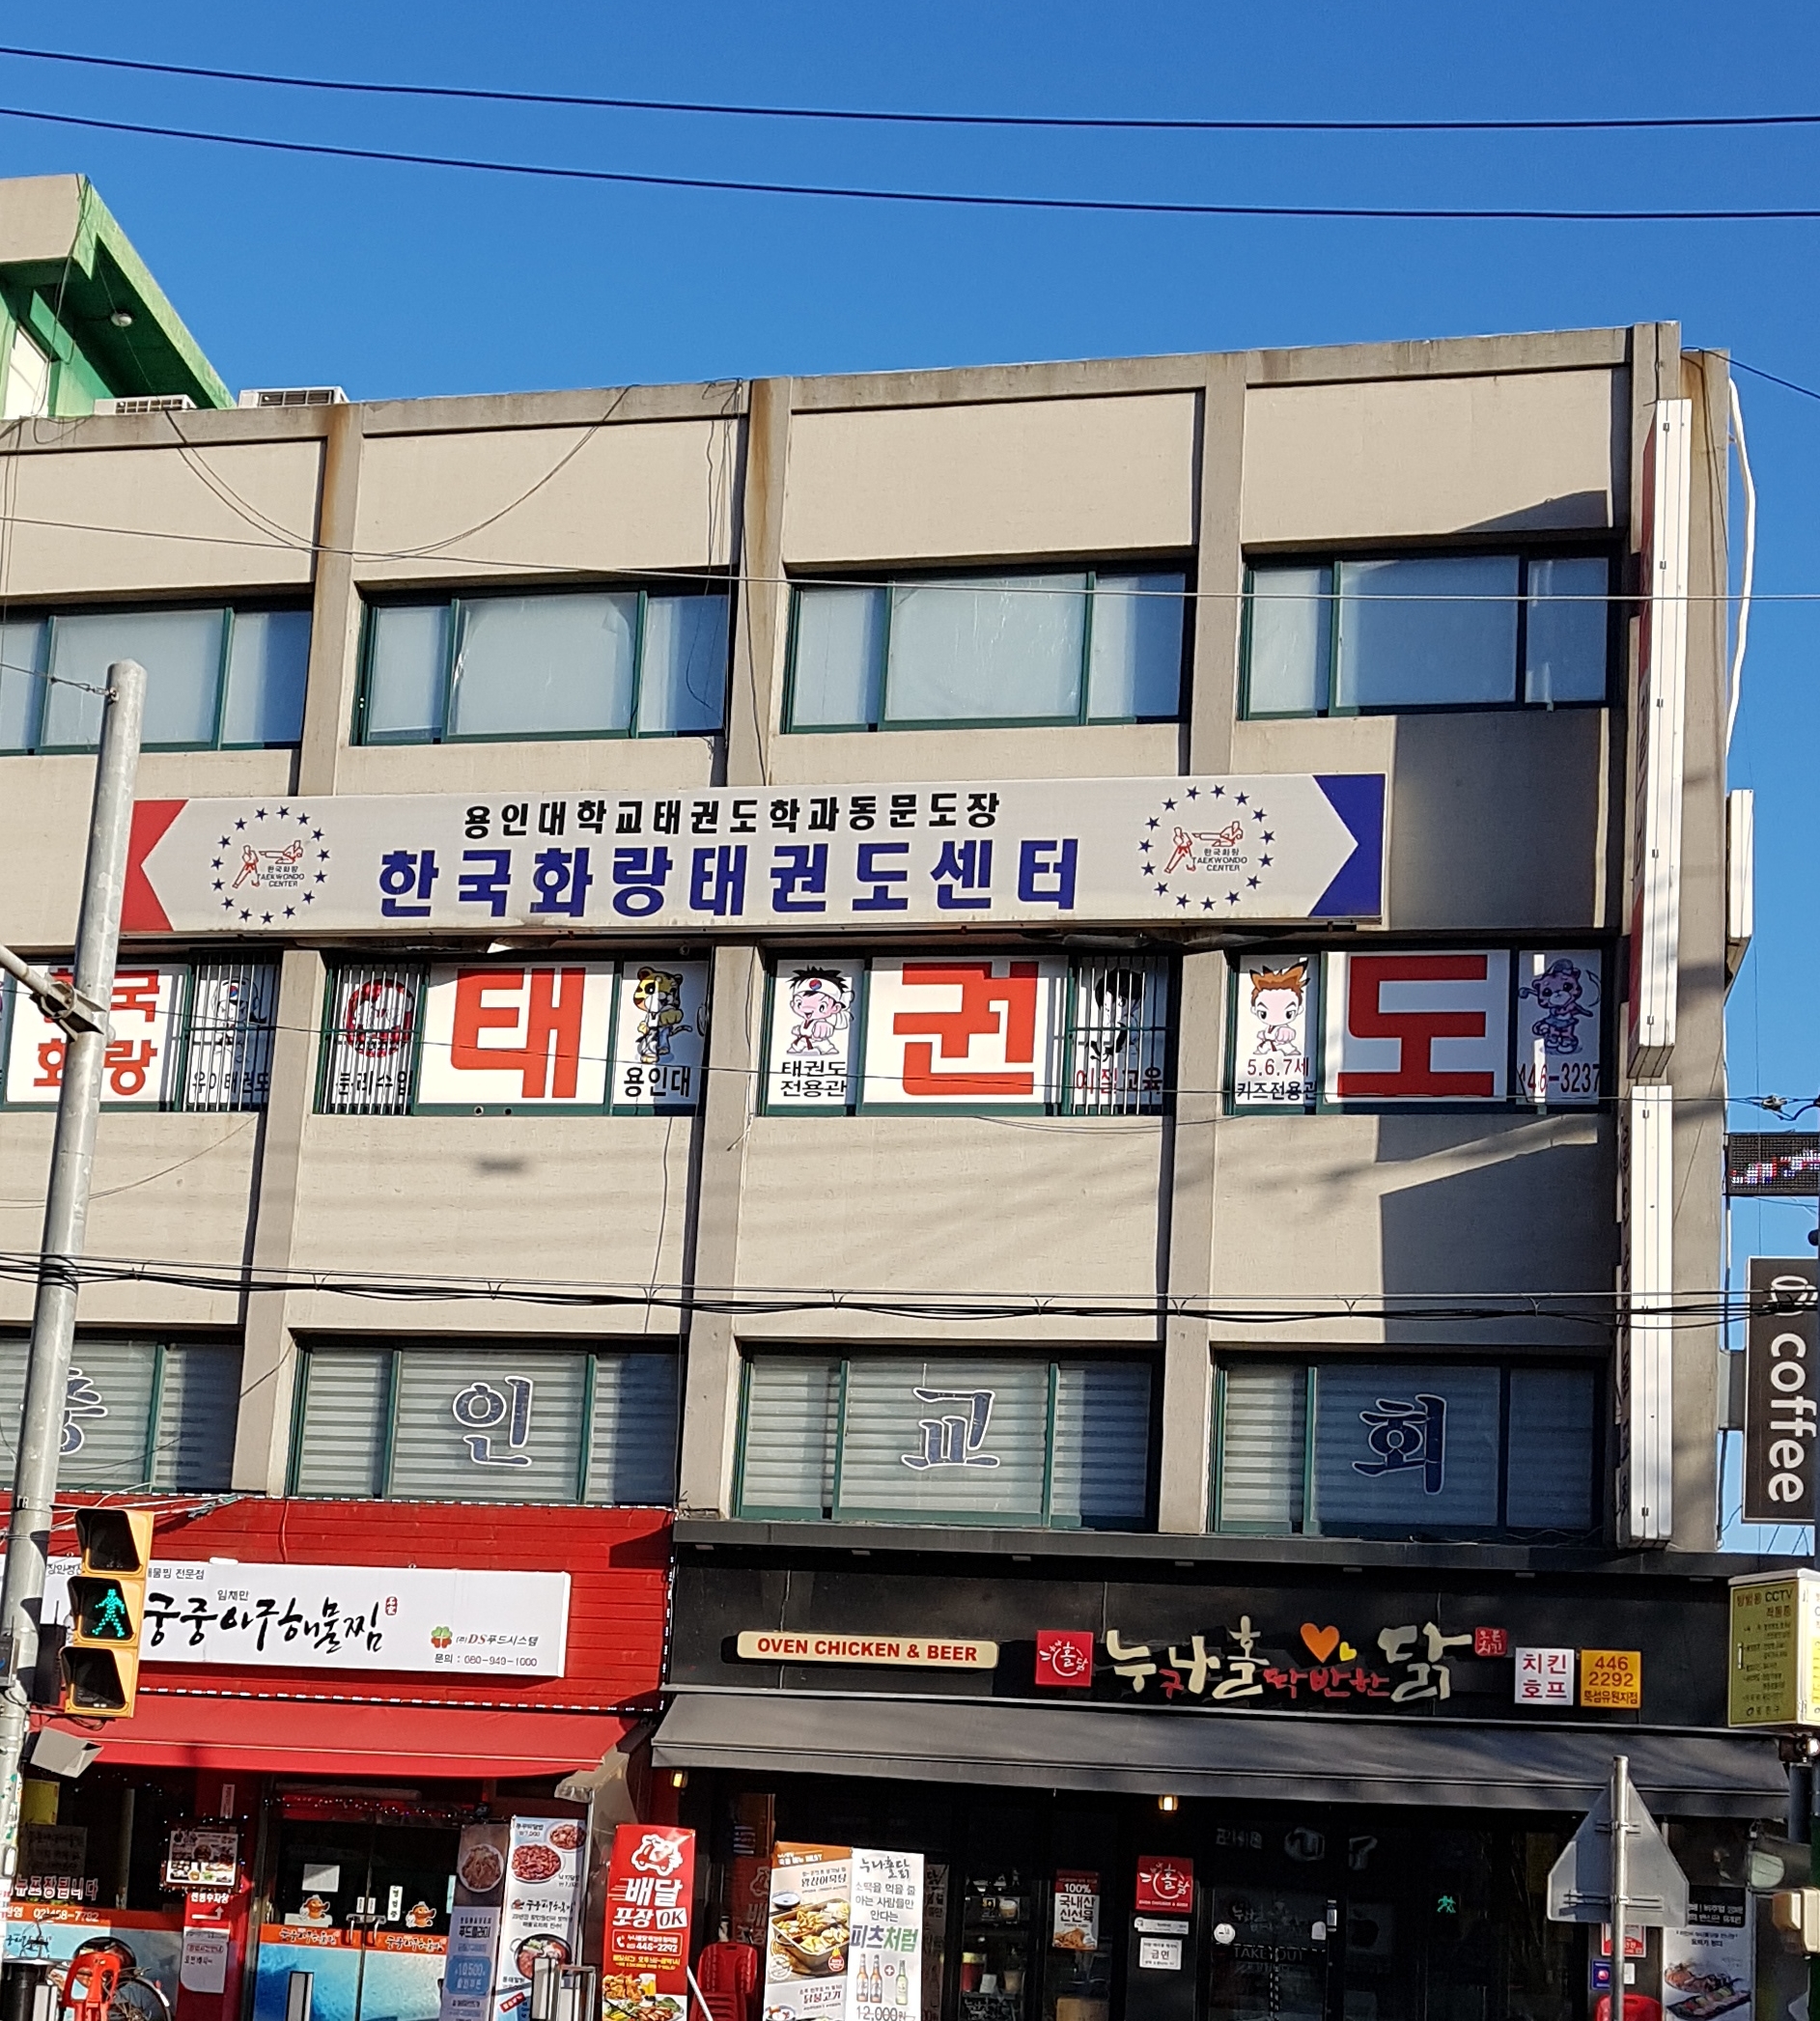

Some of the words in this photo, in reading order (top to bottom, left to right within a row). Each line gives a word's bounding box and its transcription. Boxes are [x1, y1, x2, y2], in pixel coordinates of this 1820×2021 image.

[464, 792, 1000, 839] 용인대학교태권도학과동문도장
[378, 837, 1079, 917] 한국화랑태권도센터
[450, 967, 586, 1099] 태
[892, 961, 1039, 1096] 권
[1337, 954, 1495, 1098] 도
[780, 1060, 847, 1078] 태권도
[624, 1066, 691, 1099] 용인대
[779, 1079, 848, 1099] 전용관
[1768, 1333, 1817, 1503] coffee
[452, 1375, 533, 1467] 인
[901, 1387, 1000, 1470] 교
[1352, 1392, 1447, 1497] 회
[175, 1568, 205, 1581] 전문점
[1765, 1588, 1794, 1602] CCTV
[757, 1637, 808, 1655] OVEN
[814, 1640, 900, 1659] CHICKEN
[907, 1643, 920, 1659] &
[927, 1643, 978, 1662] BEER
[1523, 1653, 1567, 1674] 치킨
[1595, 1655, 1629, 1671] 446
[1522, 1679, 1567, 1698] 호프
[1588, 1670, 1635, 1688] 2292
[10, 1873, 99, 1901] 뉴포장됩니다
[624, 1876, 684, 1907] 배달
[1064, 1882, 1092, 1895] 100%
[855, 1895, 874, 1907] 아는
[1058, 1895, 1096, 1910] 국내산
[612, 1906, 655, 1929] 포장
[658, 1909, 685, 1927] OK
[870, 1909, 899, 1923] 안다는
[1059, 1908, 1094, 1923] 신선육
[850, 1923, 919, 1952] 피츠처럼
